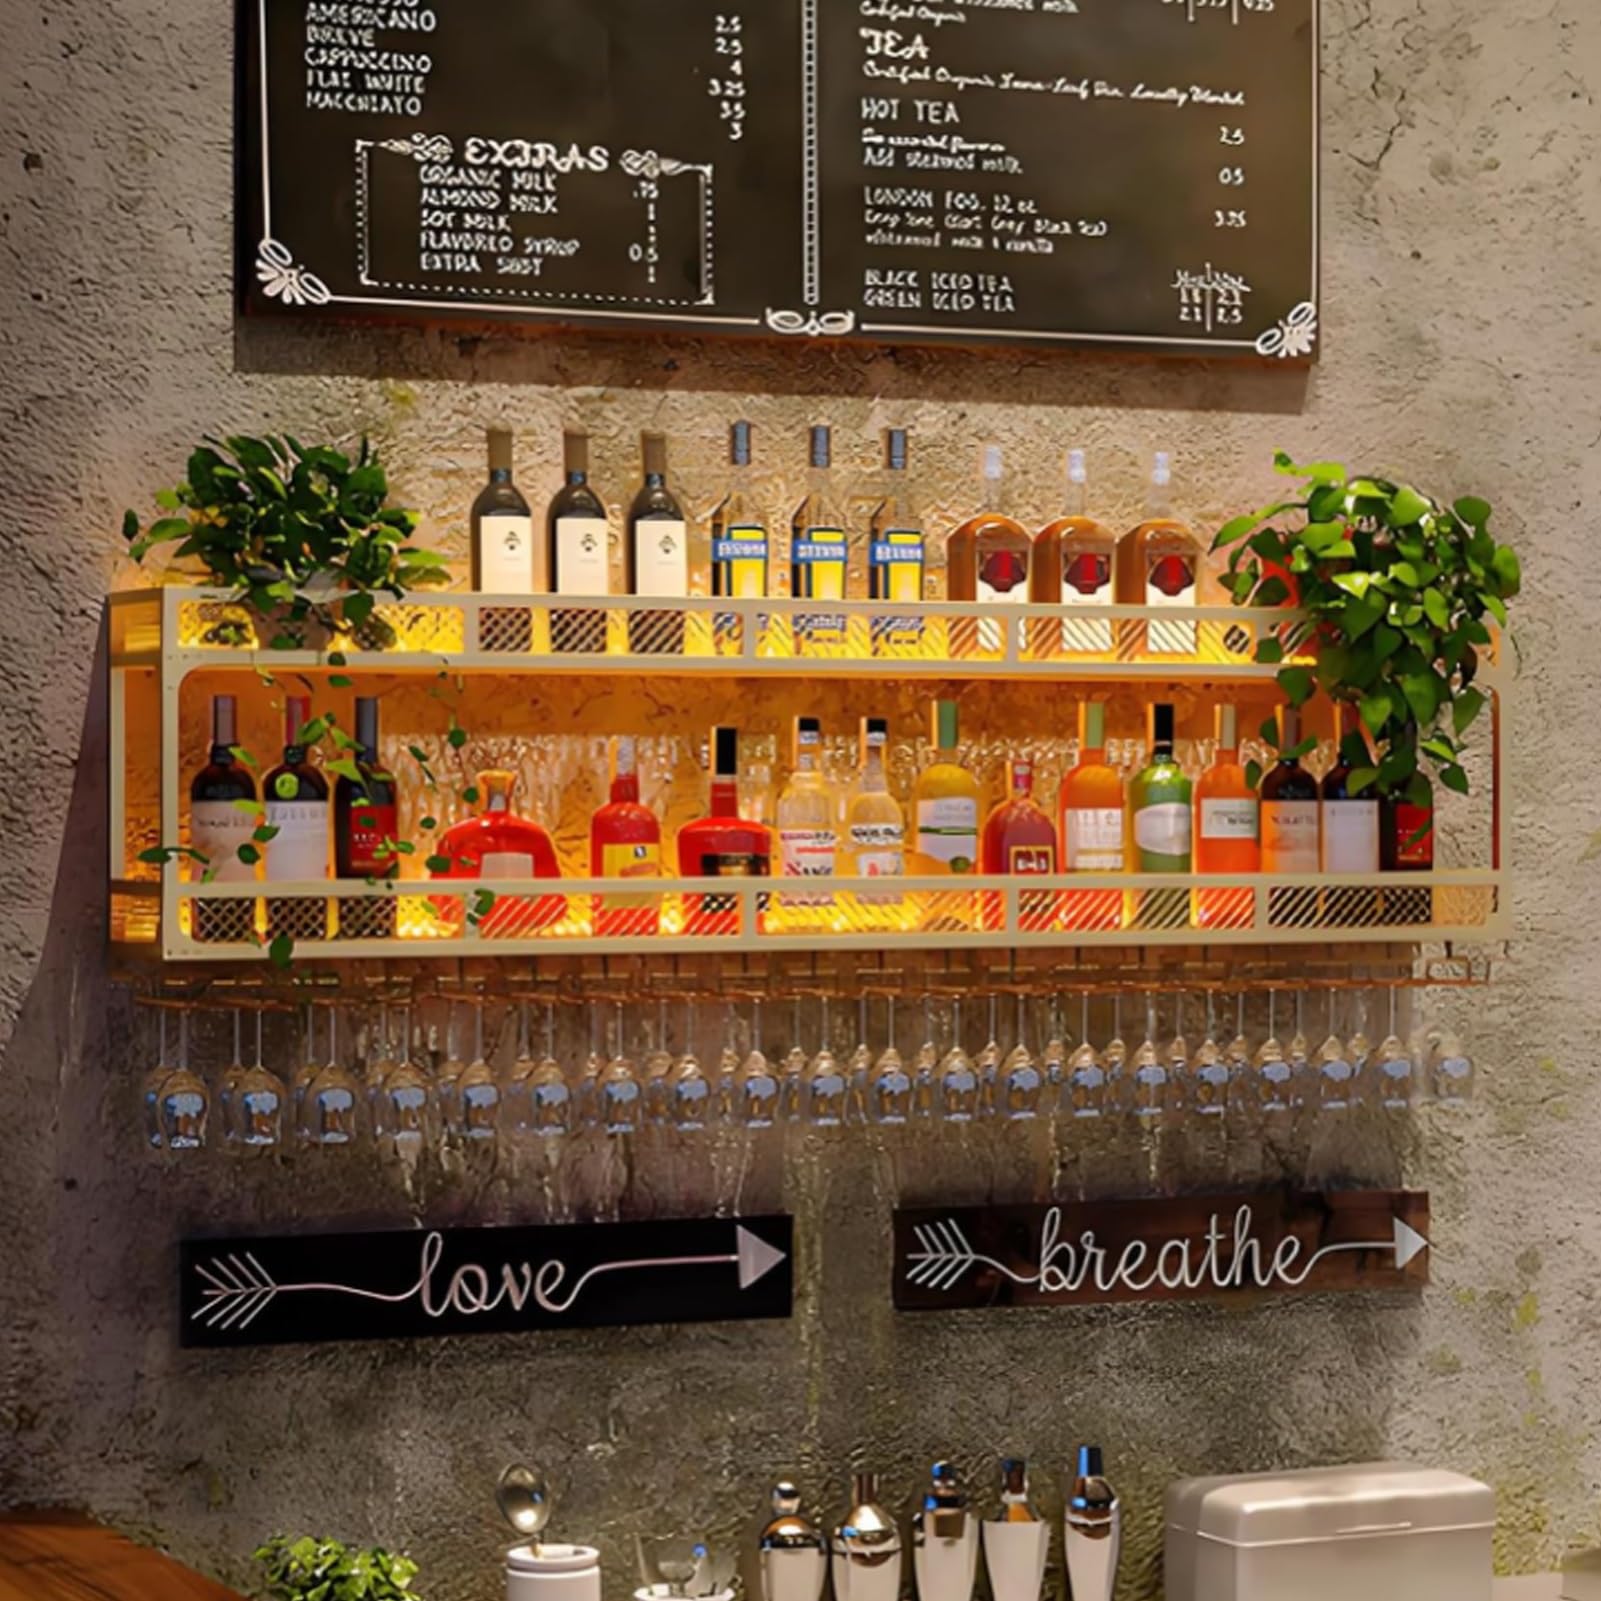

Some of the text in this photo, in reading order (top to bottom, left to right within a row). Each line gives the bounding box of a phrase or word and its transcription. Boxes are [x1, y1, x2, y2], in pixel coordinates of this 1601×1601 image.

[305, 1, 436, 31] AMERICANO
[859, 27, 930, 59] TEA
[305, 91, 422, 116] MACCHIATO
[861, 97, 960, 124] HOT TEA
[463, 136, 610, 173] EXTRAS
[510, 170, 557, 192] MILK
[508, 194, 558, 214] MILK
[1038, 1204, 1303, 1292] breathe
[418, 1232, 566, 1317] love
